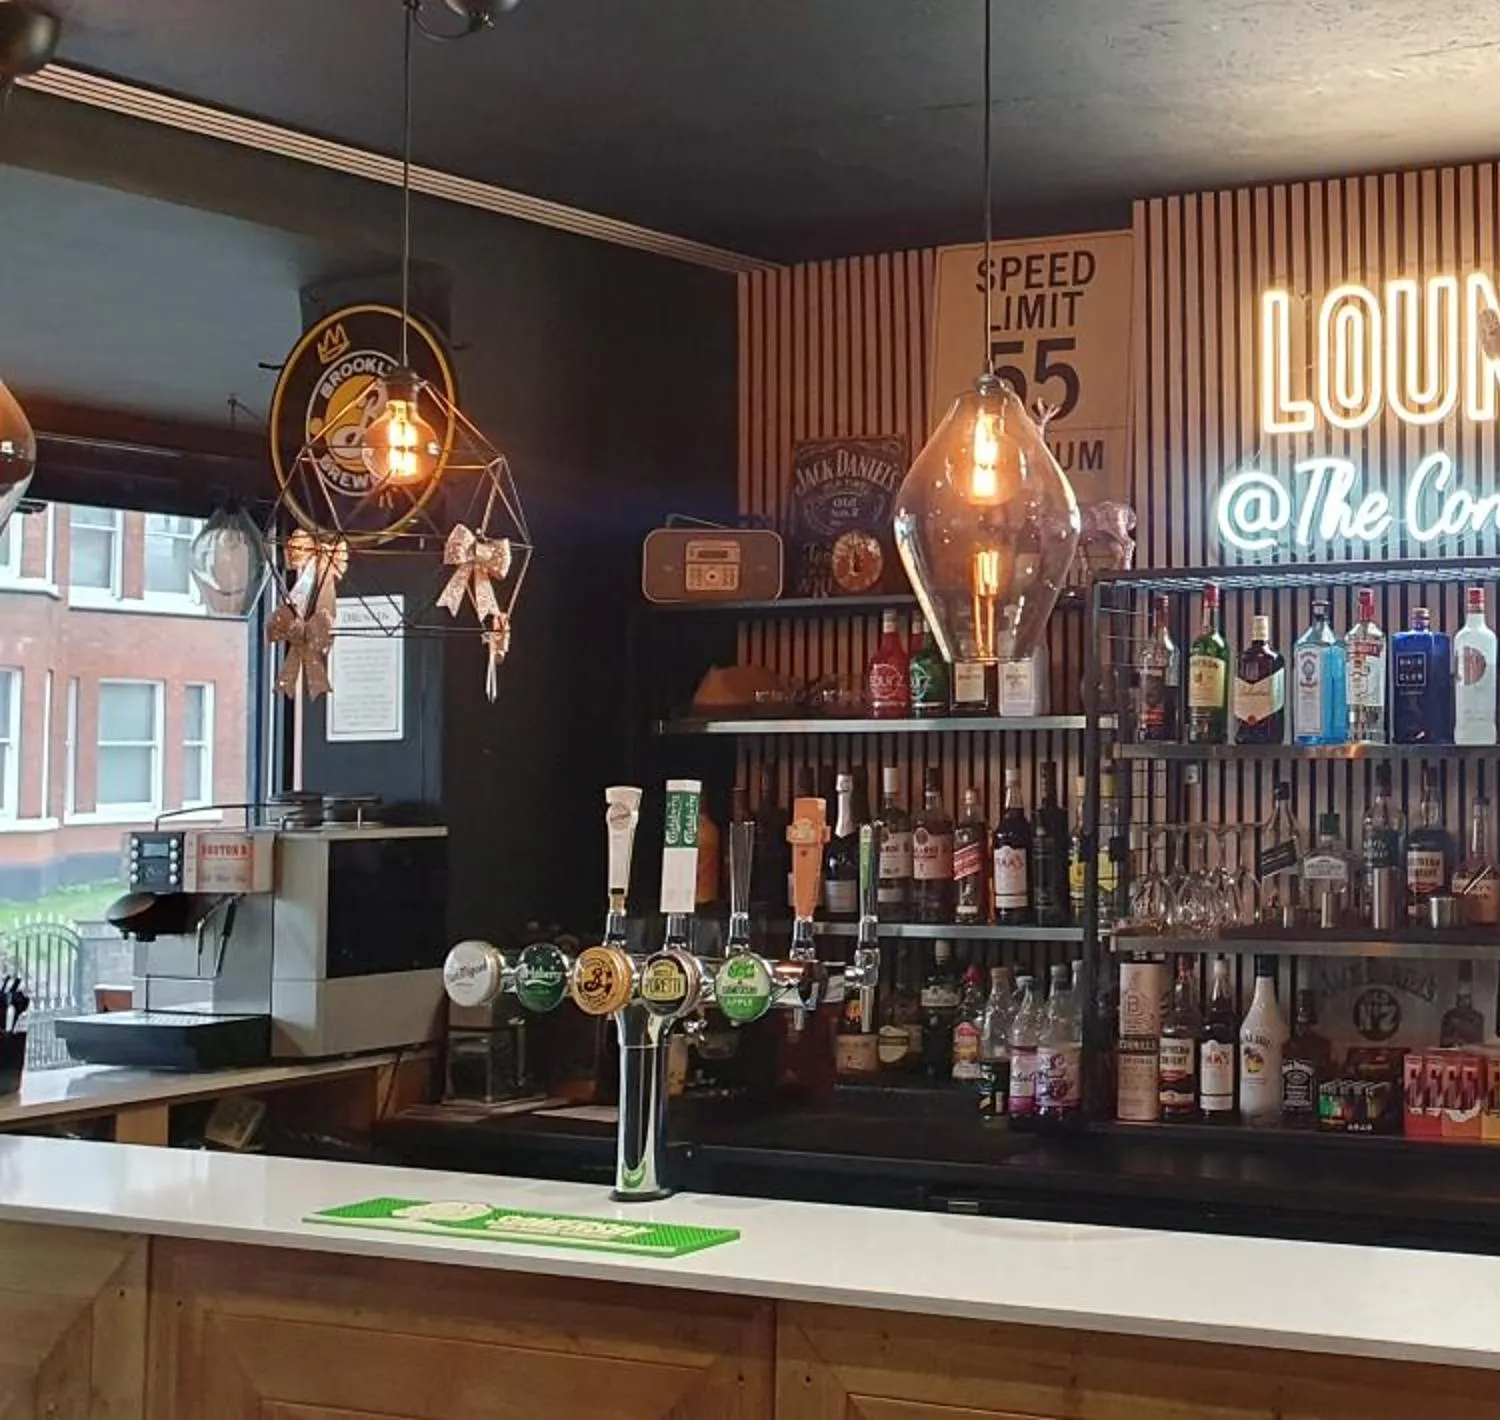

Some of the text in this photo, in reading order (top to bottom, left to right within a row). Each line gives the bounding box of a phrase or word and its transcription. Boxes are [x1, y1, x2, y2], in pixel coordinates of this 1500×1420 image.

[976, 251, 1096, 292] SPEED
[319, 356, 394, 399] BROOKL
[796, 459, 834, 496] JACK
